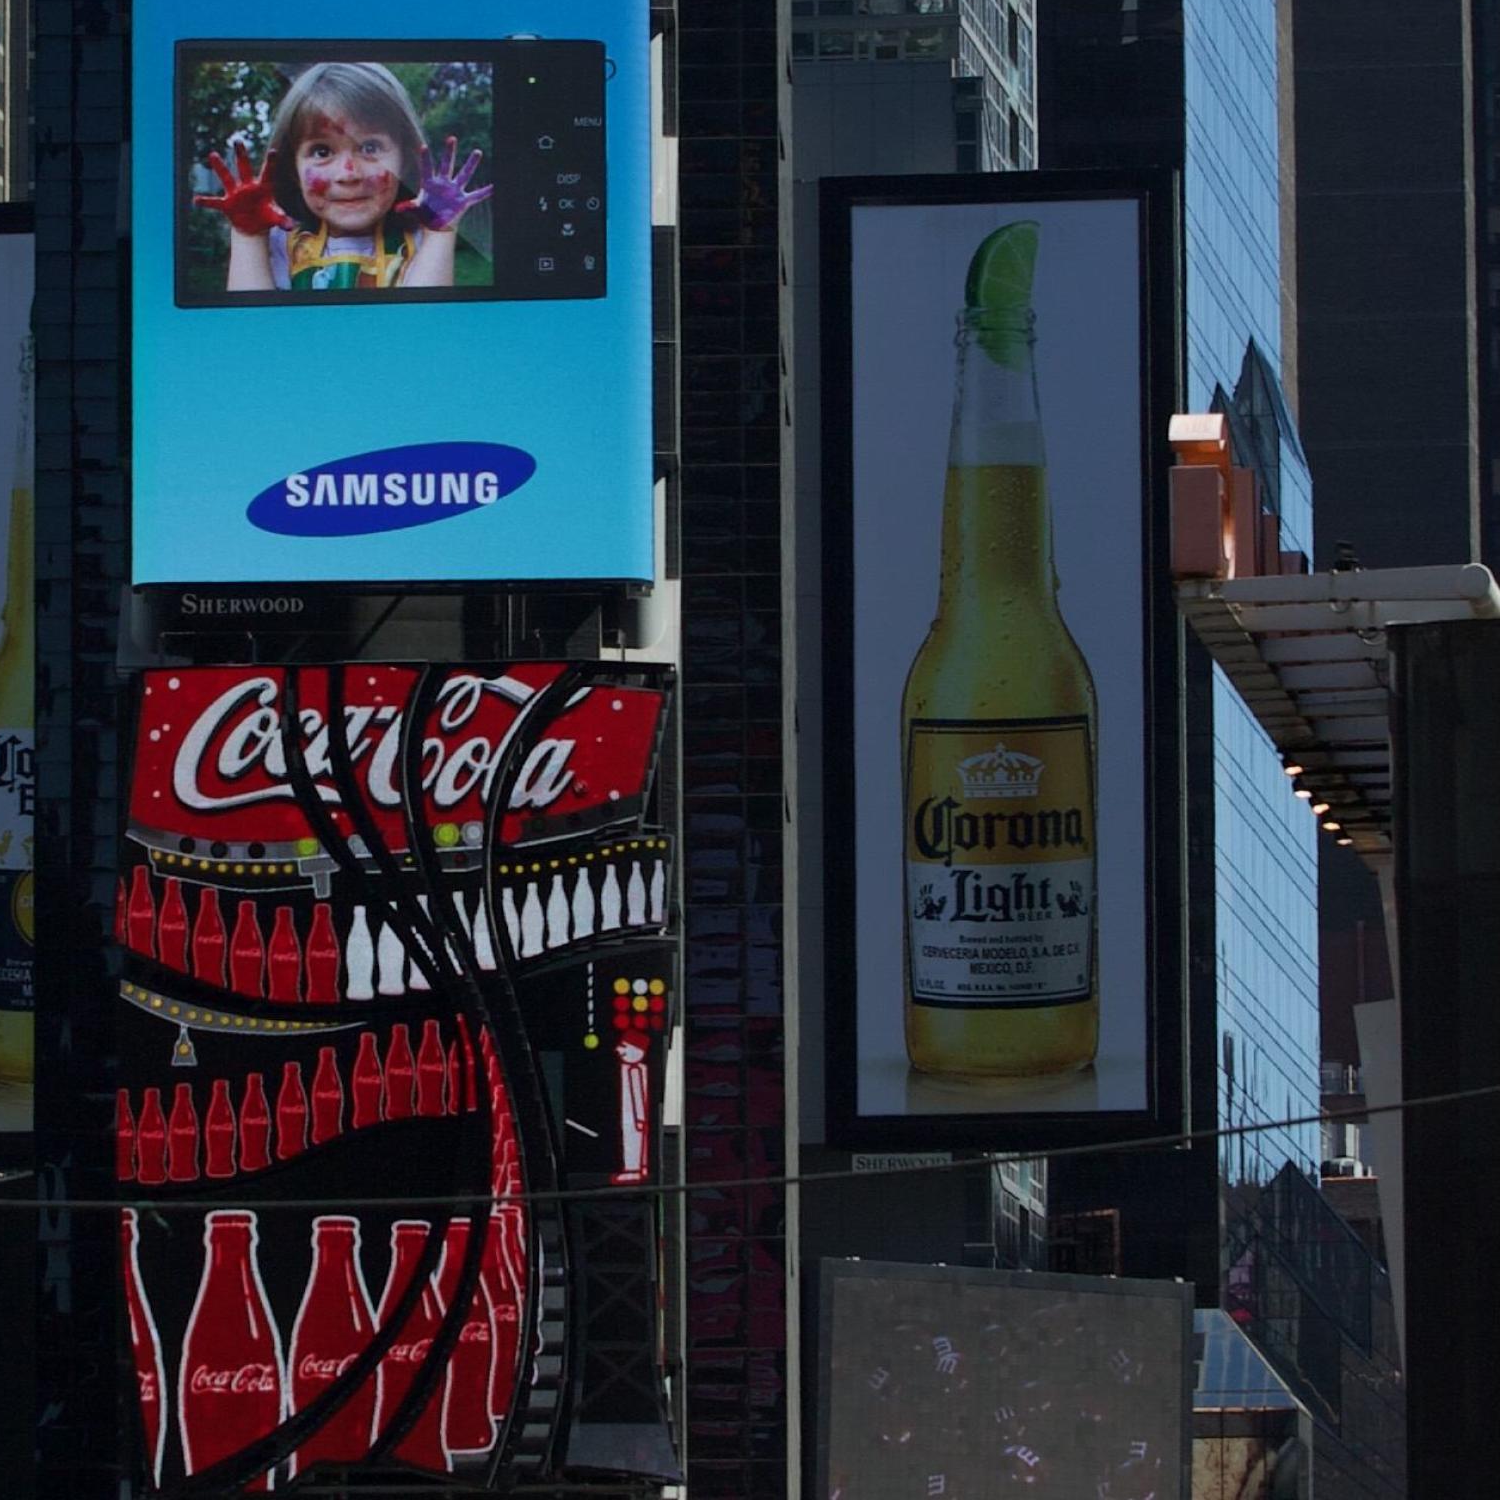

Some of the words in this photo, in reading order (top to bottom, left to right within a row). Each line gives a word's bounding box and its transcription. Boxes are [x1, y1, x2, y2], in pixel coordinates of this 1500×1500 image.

[573, 116, 602, 127] MENU
[285, 471, 499, 508] SAMSUNG
[180, 593, 304, 615] SHERWOOD
[915, 796, 1085, 867] Corona
[950, 870, 1051, 922] Light
[190, 1363, 277, 1395] Coca-Cola
